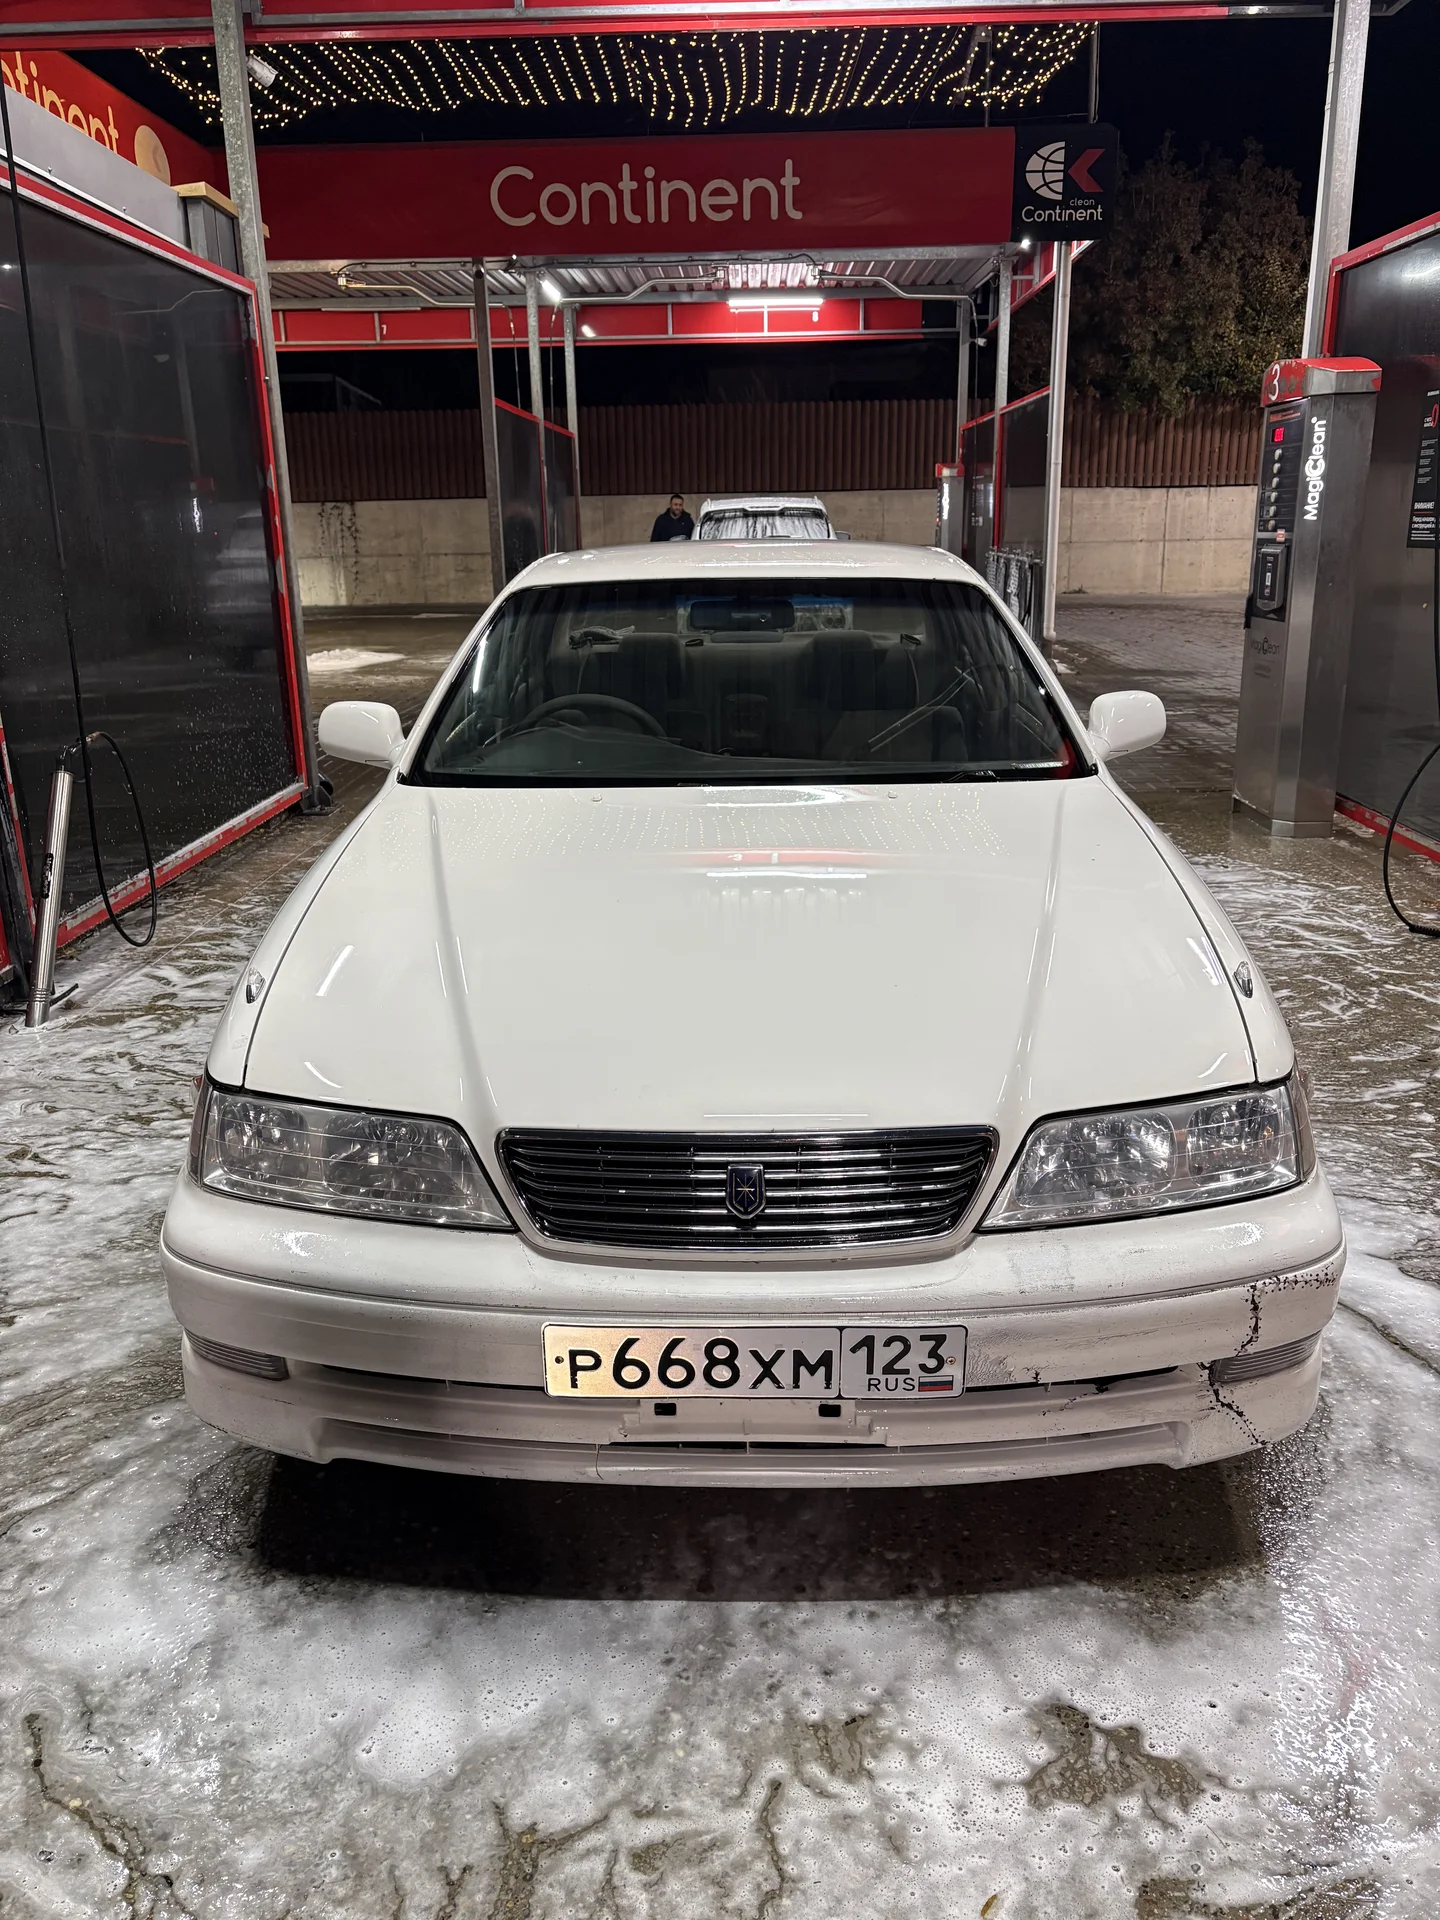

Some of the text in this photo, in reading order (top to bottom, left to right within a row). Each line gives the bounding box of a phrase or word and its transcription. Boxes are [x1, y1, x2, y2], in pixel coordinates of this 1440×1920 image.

[490, 158, 803, 227] Continent
[1069, 198, 1095, 206] clean
[1021, 204, 1103, 222] Continent
[1268, 363, 1280, 401] 3
[849, 1333, 947, 1376] 123
[868, 1376, 916, 1392] RUS
